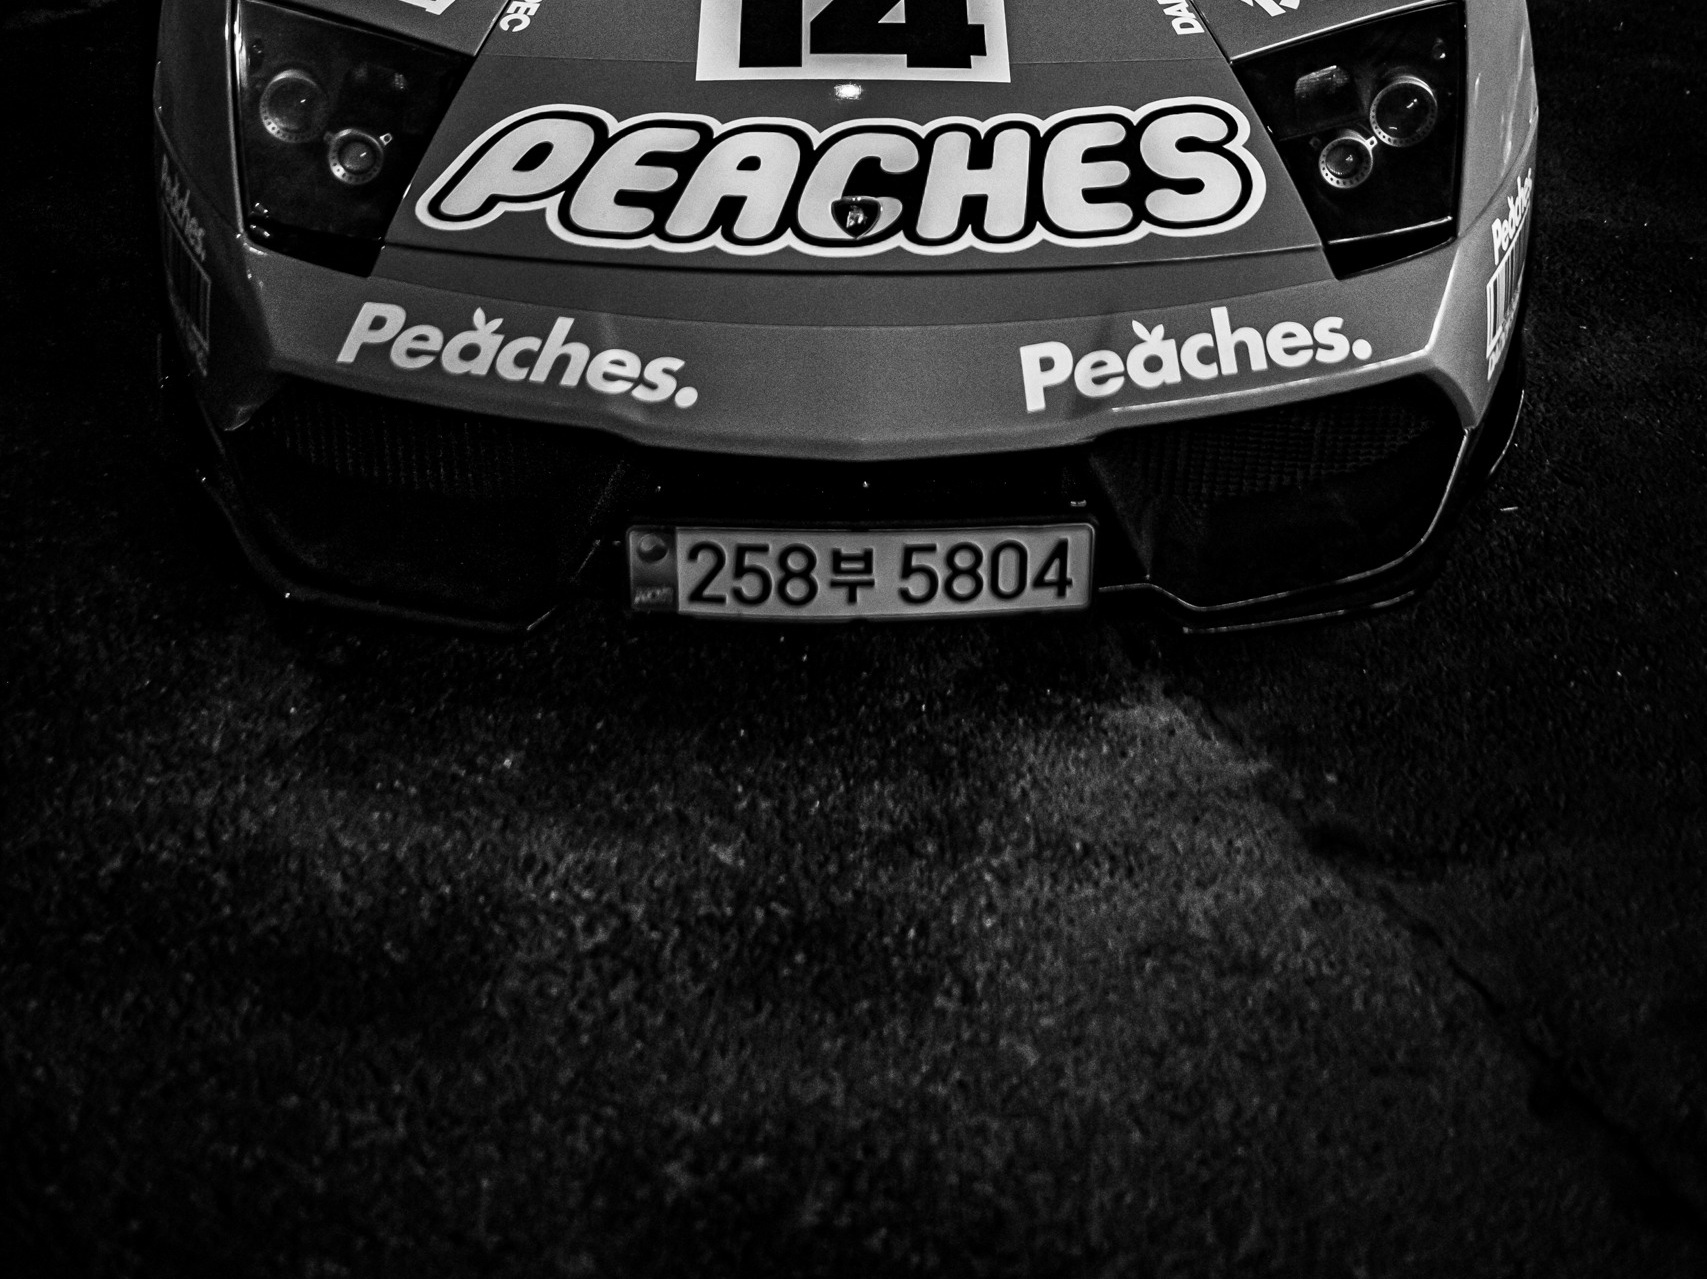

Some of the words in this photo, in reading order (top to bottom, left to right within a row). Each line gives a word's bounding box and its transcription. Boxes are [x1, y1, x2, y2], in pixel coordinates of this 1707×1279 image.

[414, 95, 1267, 260] PEACHES
[687, 540, 876, 606] 258부
[899, 538, 1074, 604] 5804
